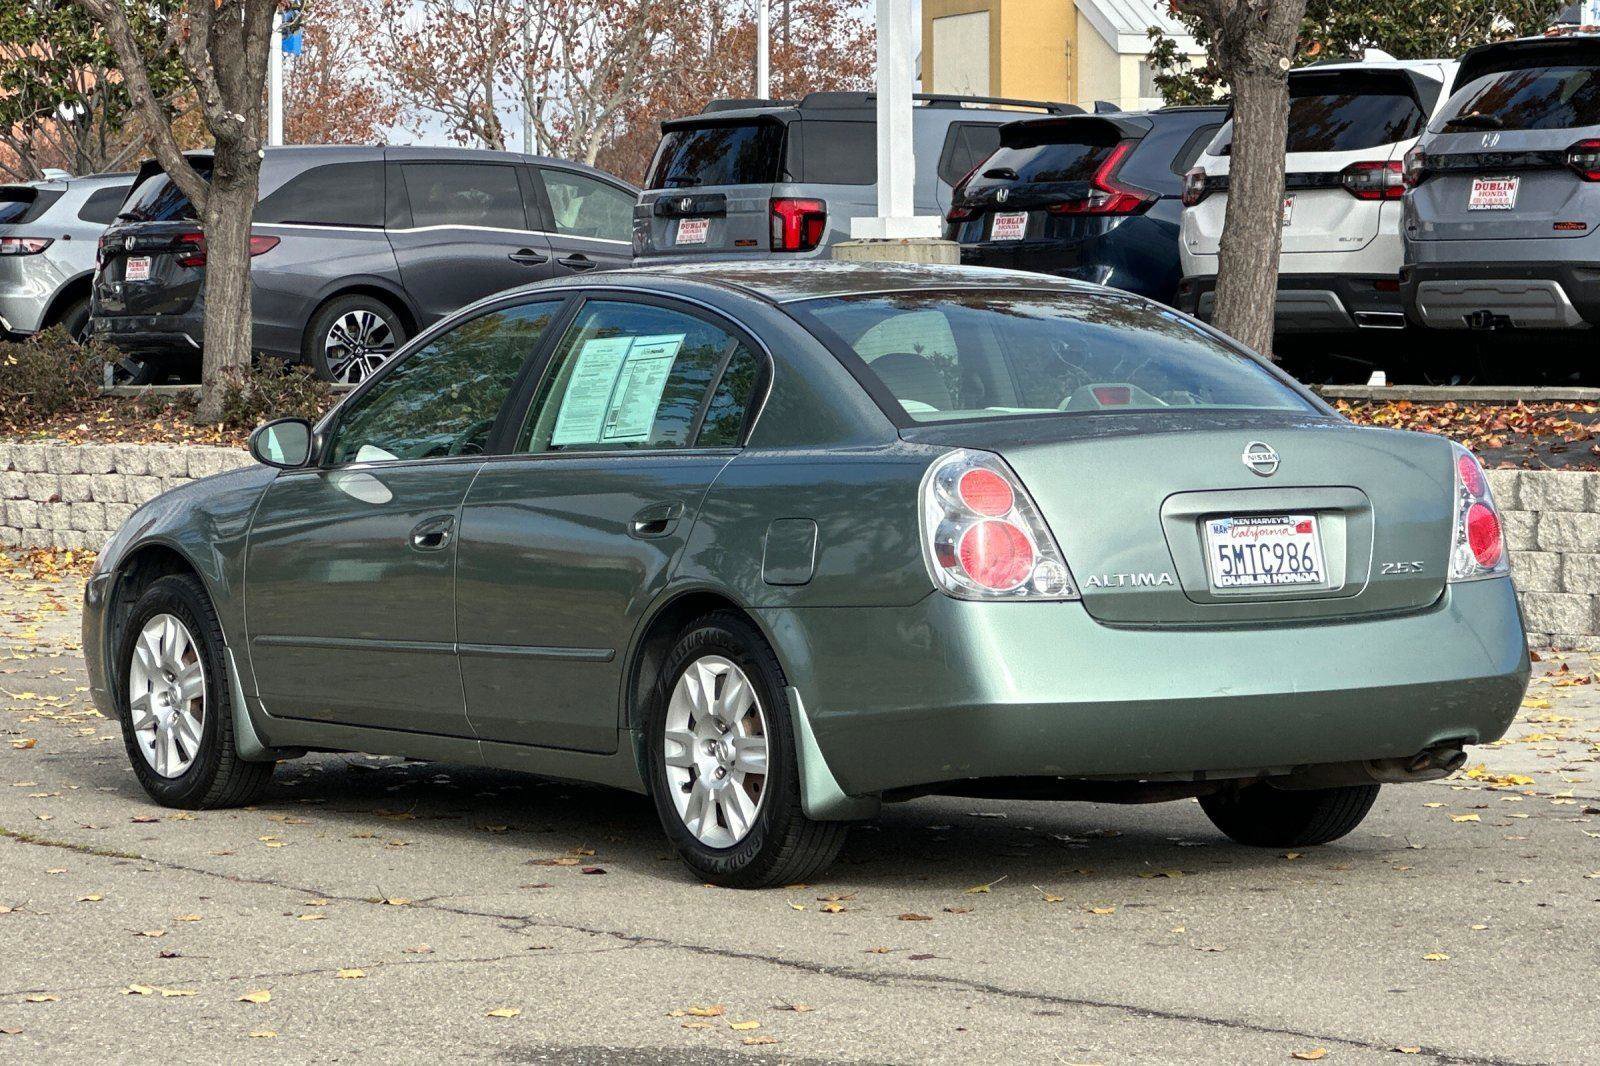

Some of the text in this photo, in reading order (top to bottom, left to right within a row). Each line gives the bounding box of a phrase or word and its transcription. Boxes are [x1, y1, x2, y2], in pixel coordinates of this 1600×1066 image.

[1475, 182, 1515, 190] DUBLIN
[996, 217, 1025, 225] DUBLIN
[1248, 453, 1278, 461] NISSAN
[1233, 517, 1289, 526] KEN HARVEY'S
[1231, 525, 1296, 541] California
[1218, 541, 1314, 575] 5MTC986
[1083, 572, 1174, 588] ALTIMA
[1222, 572, 1319, 586] DUBLIN HONDA
